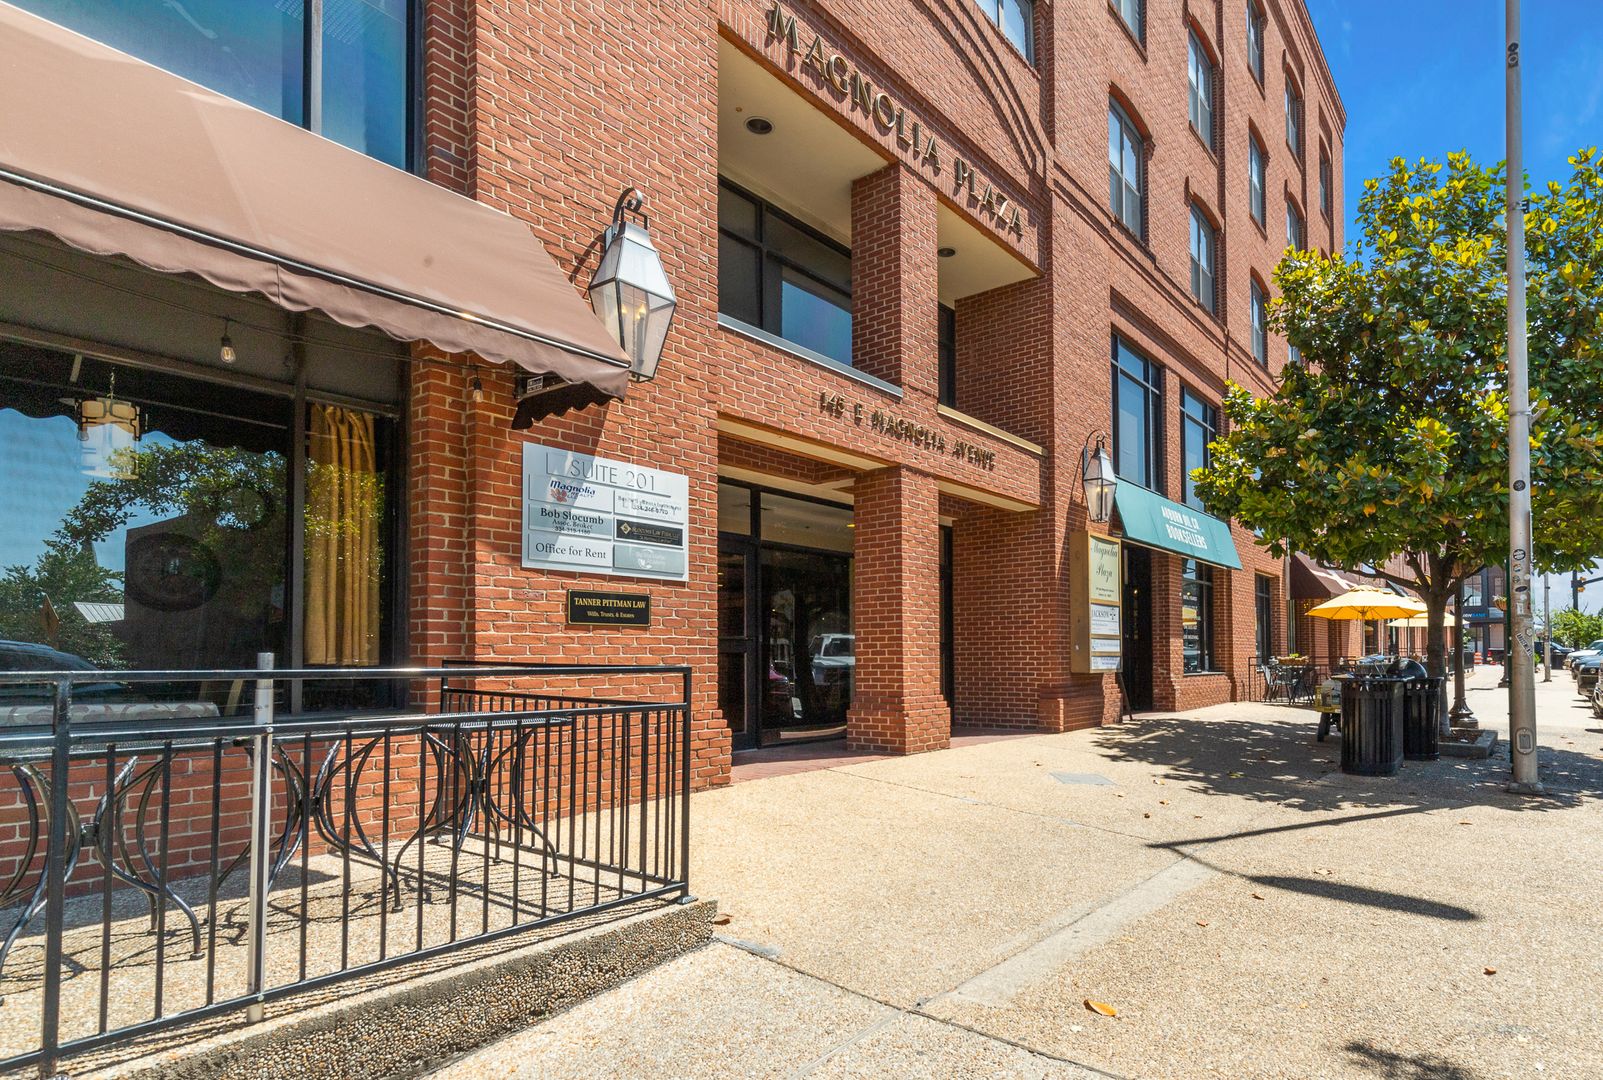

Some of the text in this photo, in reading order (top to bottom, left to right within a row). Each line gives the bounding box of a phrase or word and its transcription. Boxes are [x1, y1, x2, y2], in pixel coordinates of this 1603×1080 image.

[769, 3, 1024, 237] MAGNOLIA PLAZA
[872, 409, 946, 453] MAGNOLIA
[953, 439, 996, 469] AVENUE
[570, 459, 655, 491] SUITE 201
[550, 480, 596, 496] Magnolia
[540, 507, 604, 525] Bob Slocumb
[1165, 523, 1208, 549] BOOKSELLERS
[535, 542, 606, 559] Office for Rent
[574, 597, 646, 609] TANNER PITTMAN LAW
